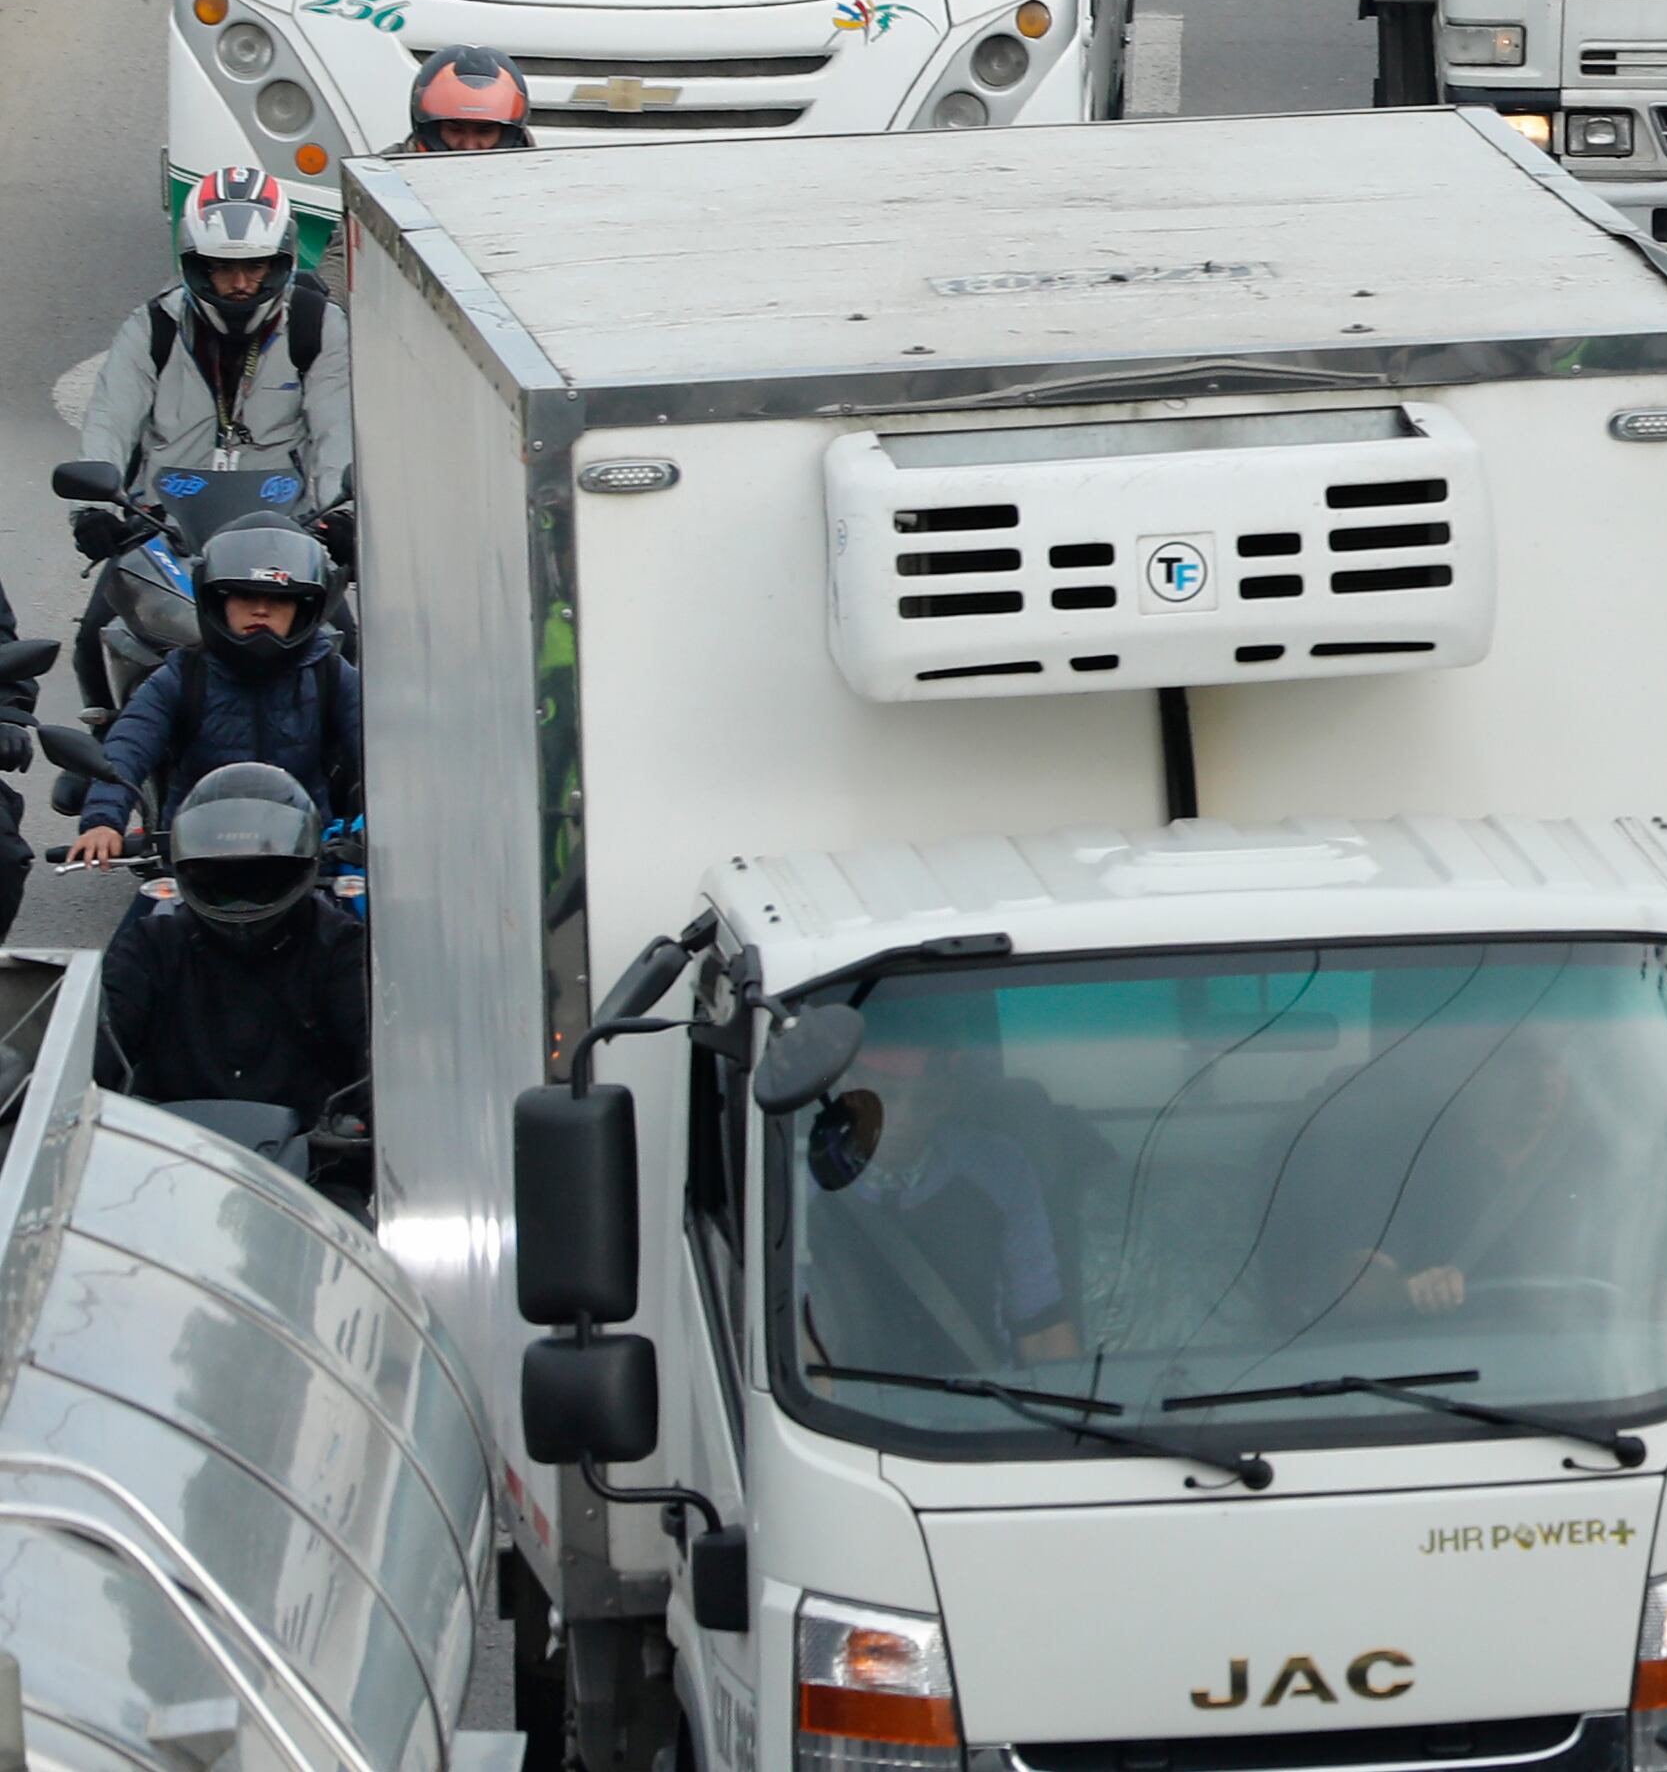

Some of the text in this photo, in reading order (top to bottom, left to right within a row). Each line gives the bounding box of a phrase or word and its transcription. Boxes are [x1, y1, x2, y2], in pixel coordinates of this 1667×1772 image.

[1156, 556, 1199, 592] TF
[1418, 1525, 1485, 1556] JHR
[1189, 1647, 1417, 1711] JAC
